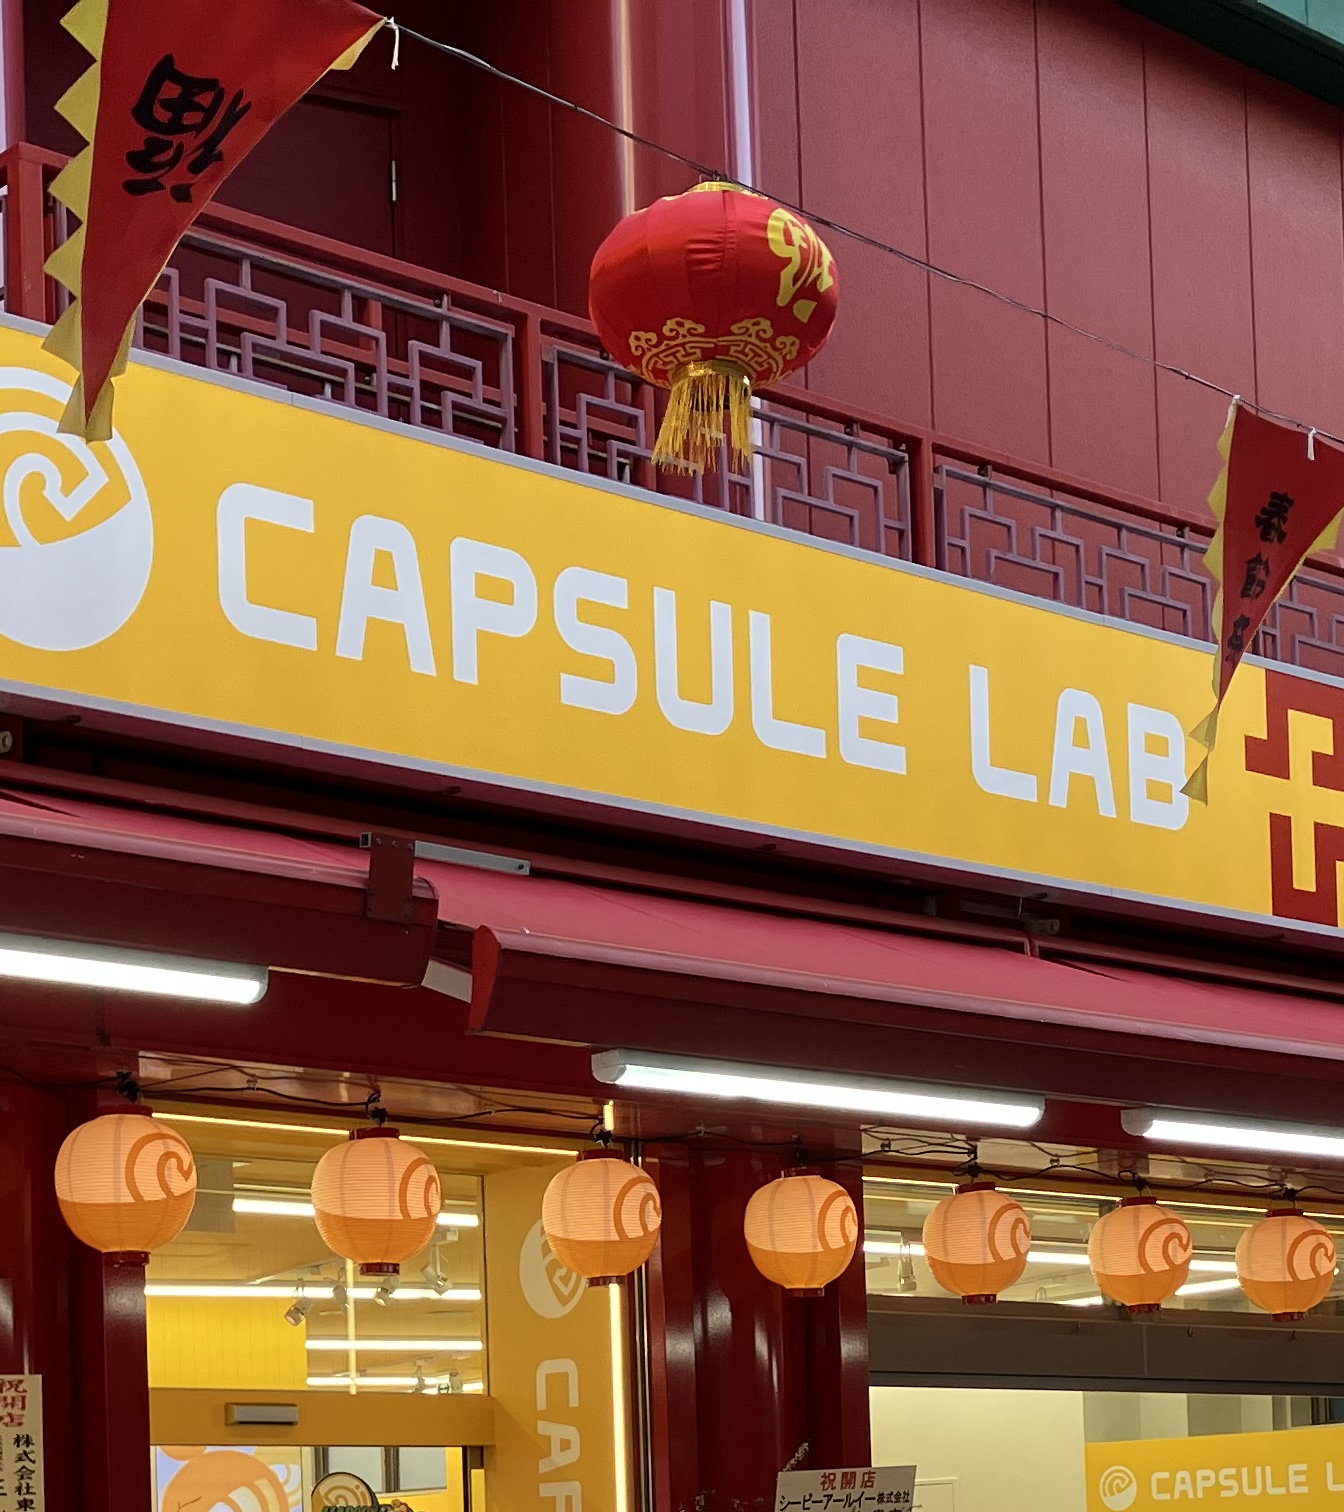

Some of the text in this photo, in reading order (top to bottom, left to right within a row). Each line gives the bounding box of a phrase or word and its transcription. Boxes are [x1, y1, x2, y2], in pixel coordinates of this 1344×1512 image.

[216, 482, 1191, 832] CAPSULE LAB
[820, 1470, 877, 1492] 祝開店
[1150, 1463, 1309, 1501] CAPSULE
